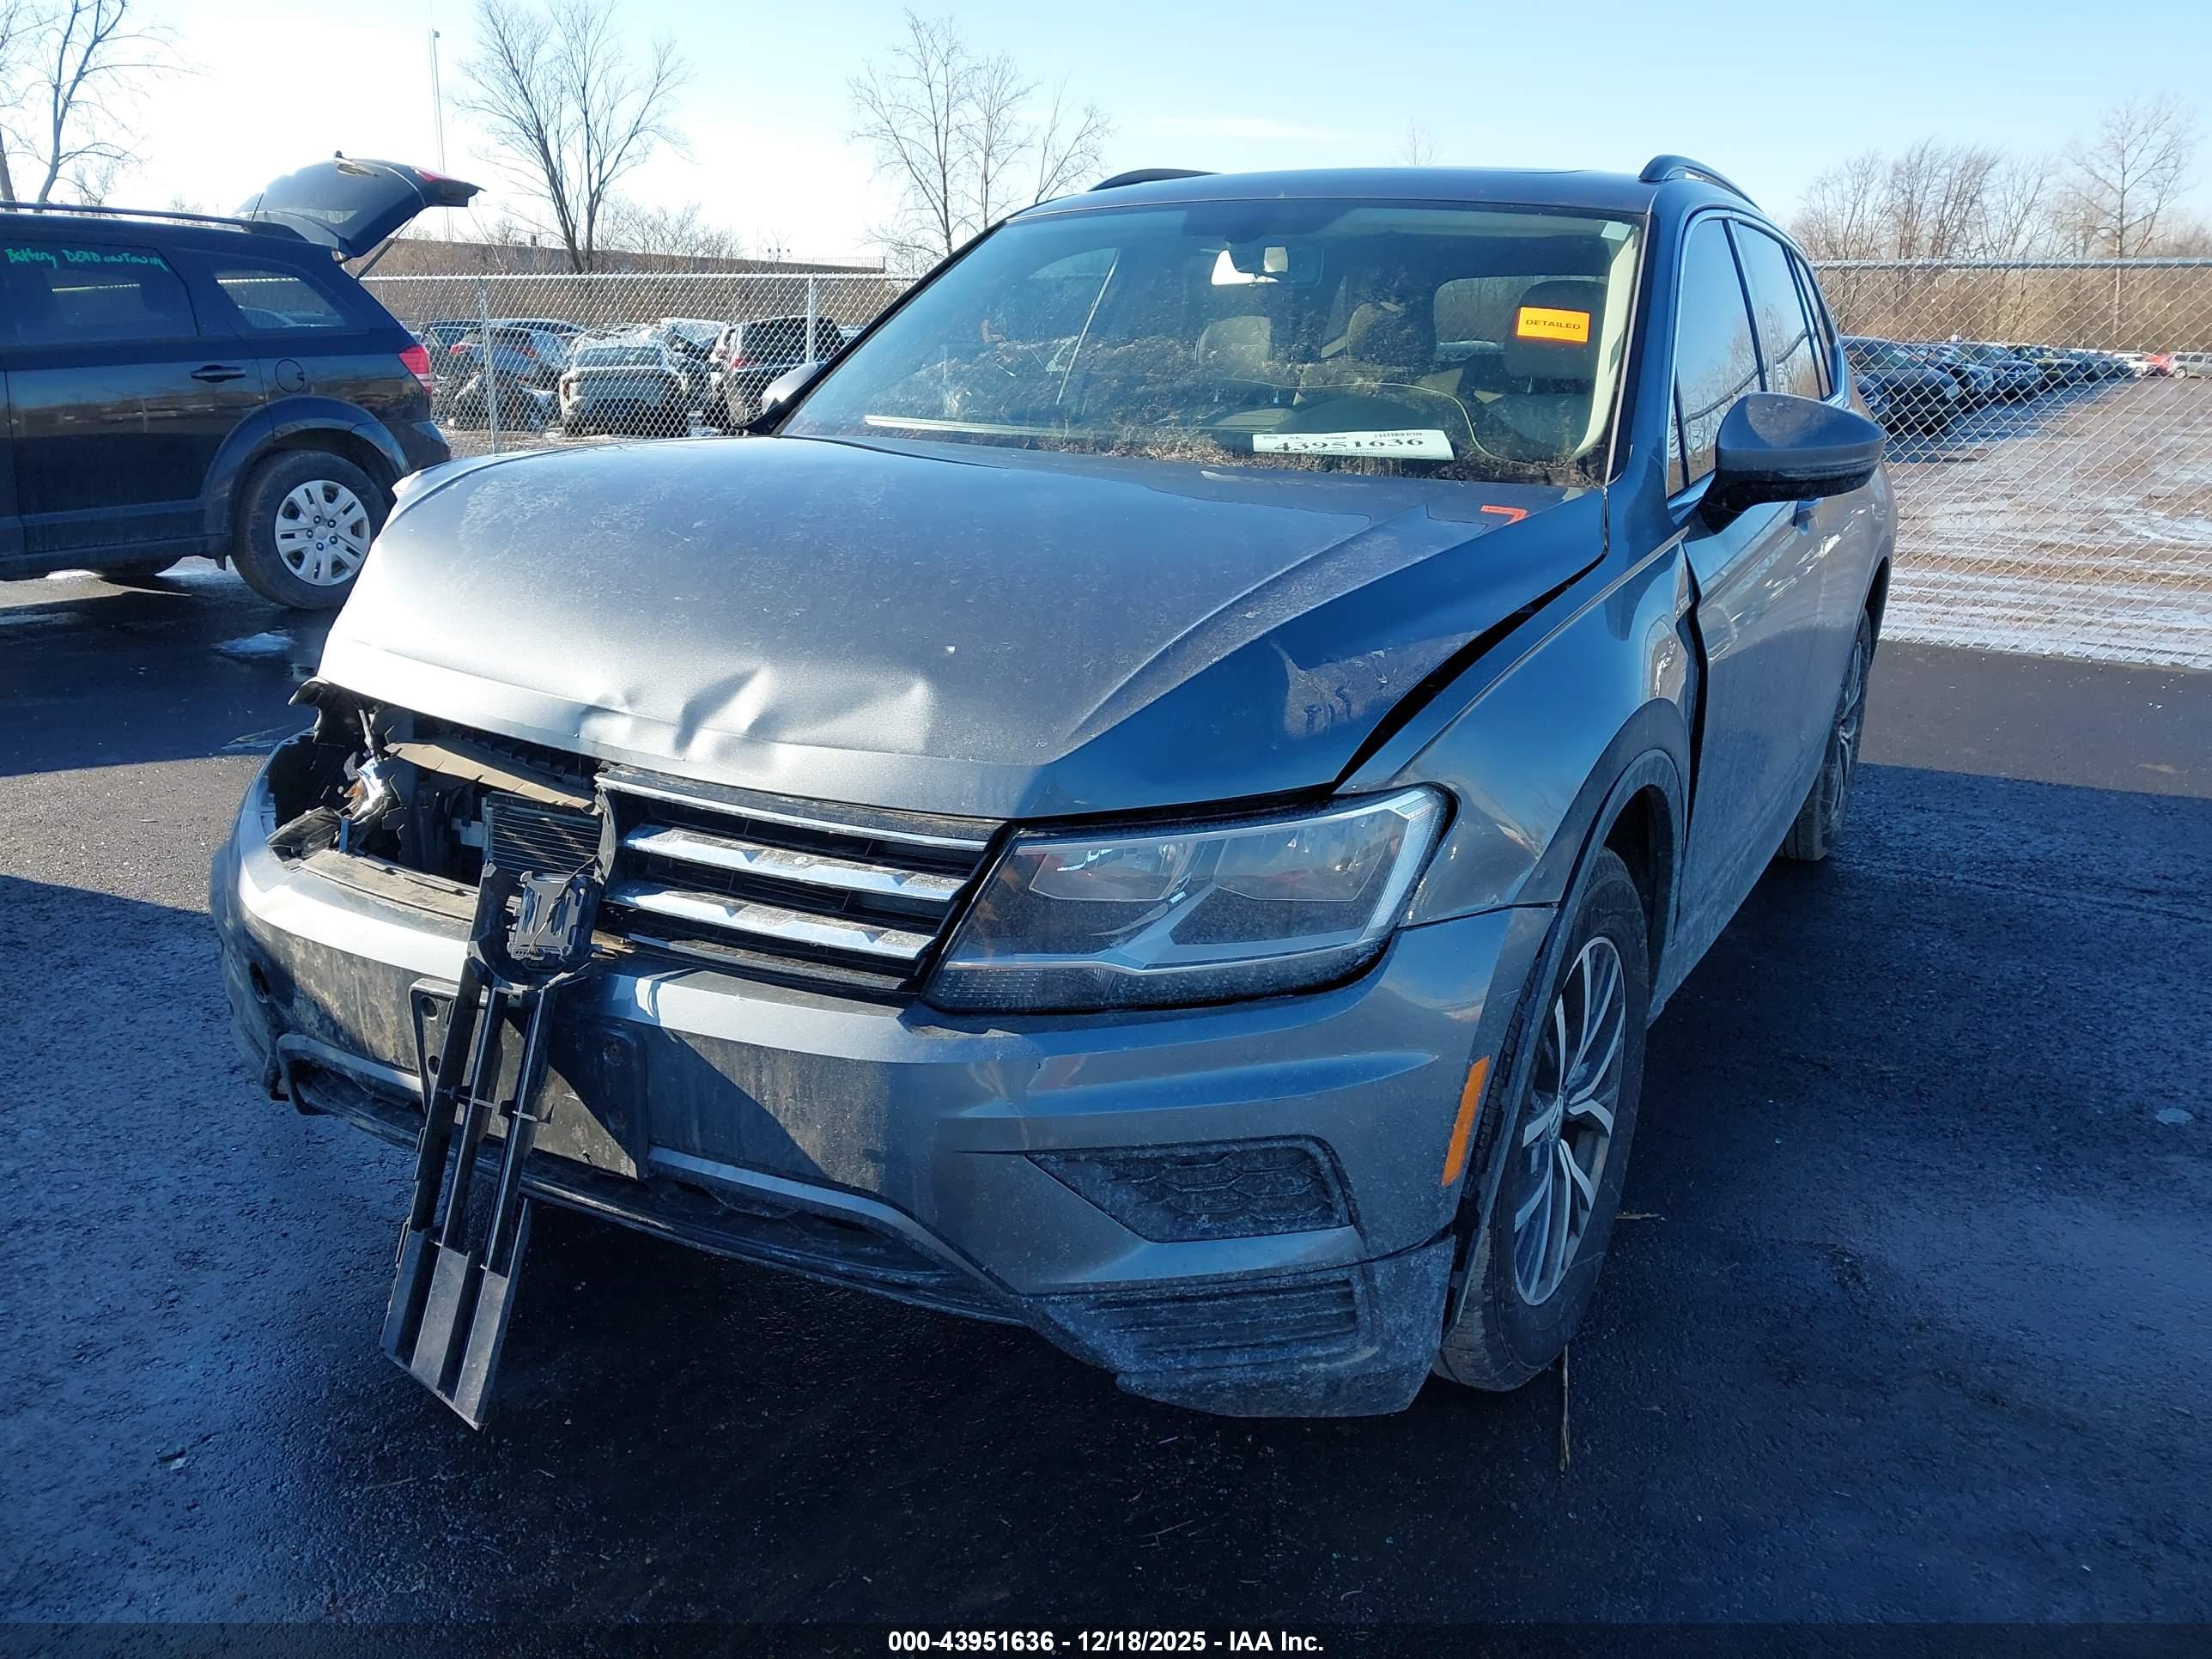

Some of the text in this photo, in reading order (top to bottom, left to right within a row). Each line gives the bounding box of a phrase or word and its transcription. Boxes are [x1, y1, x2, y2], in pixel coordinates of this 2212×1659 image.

[62, 249, 101, 263] DEAD
[1525, 319, 1582, 330] DETAILED
[1273, 438, 1425, 453] 43951636
